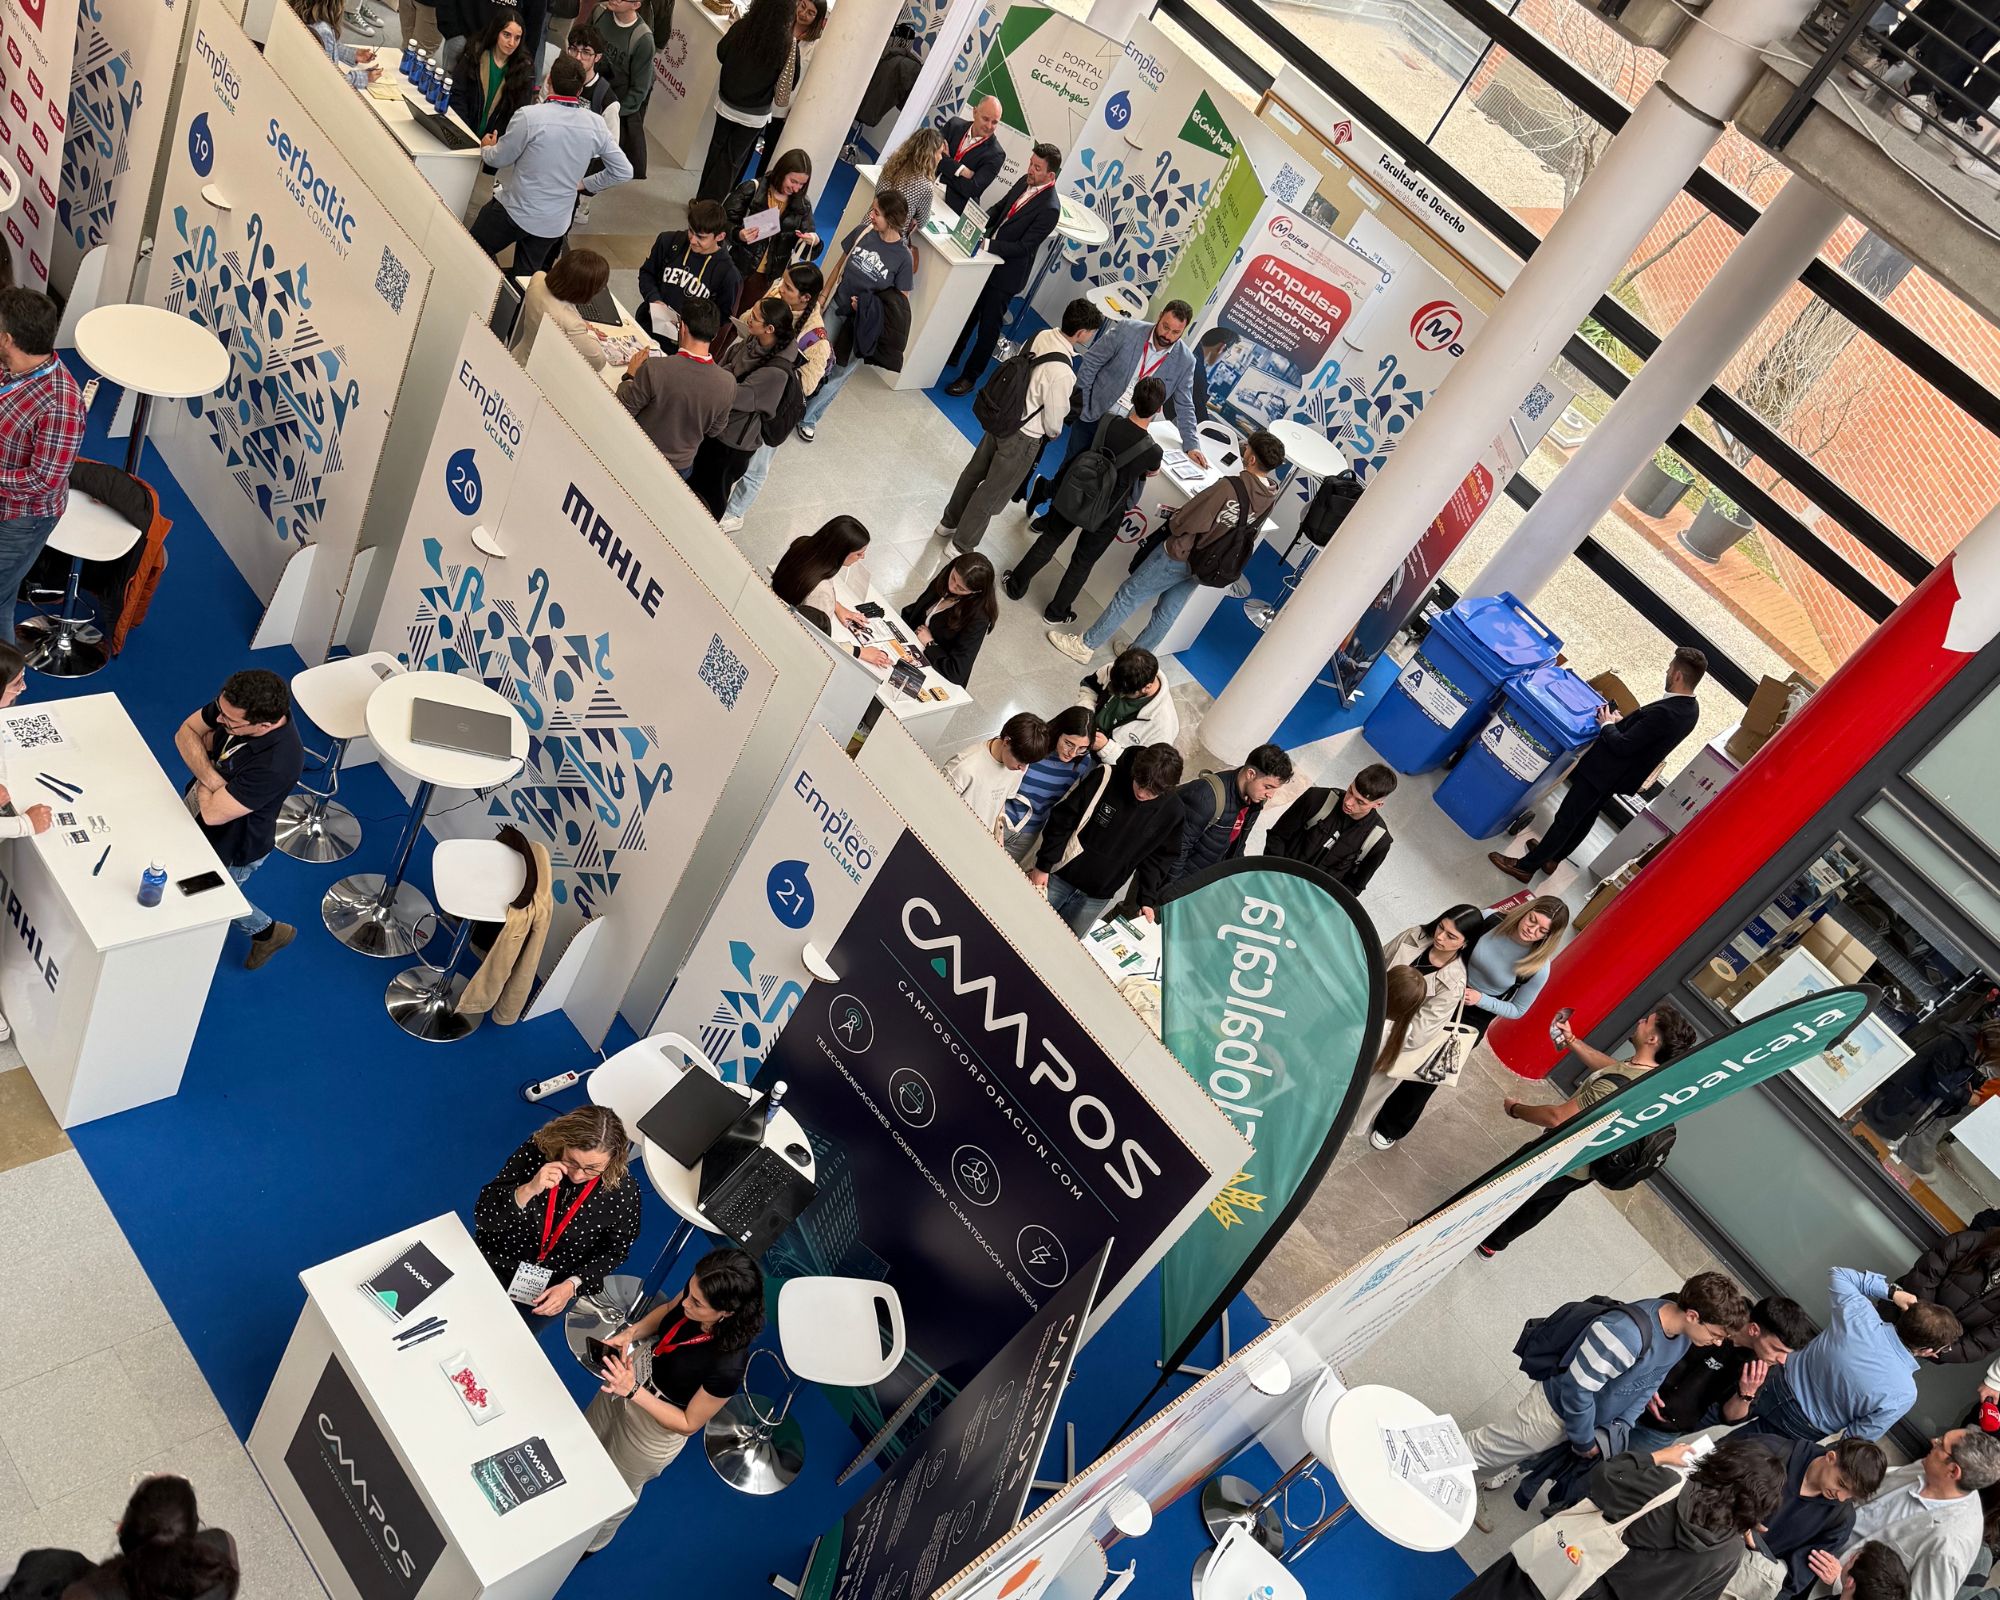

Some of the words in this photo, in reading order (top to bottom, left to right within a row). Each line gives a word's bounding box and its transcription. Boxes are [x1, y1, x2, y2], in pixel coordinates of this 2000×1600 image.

[196, 29, 239, 100] Empleo
[1038, 54, 1054, 68] DE
[1055, 63, 1098, 90] EMPLEO
[1063, 51, 1103, 79] PORTAL
[1124, 40, 1165, 84] Empleo
[1110, 103, 1127, 122] 49
[195, 133, 208, 161] 19
[266, 118, 356, 244] serbatic
[1378, 154, 1418, 192] Facultad
[1416, 187, 1429, 202] de
[1429, 197, 1465, 233] Derecho
[277, 167, 282, 180] A
[285, 175, 306, 207] VASS
[307, 204, 349, 261] COMPANY
[1275, 223, 1309, 249] Meisa
[1255, 278, 1263, 286] tu
[1261, 281, 1331, 335] CARRERA
[1262, 259, 1342, 319] ¡Impulsa
[1234, 302, 1256, 319] laborales
[1255, 317, 1267, 327] para
[1267, 325, 1295, 346] estudiantes
[1244, 287, 1257, 298] con
[1254, 291, 1326, 345] Nosotros!
[1272, 336, 1292, 352] perfiles
[459, 360, 521, 446] Empleo
[493, 389, 500, 401] 19
[504, 402, 517, 422] Foro
[516, 419, 525, 432] de
[484, 419, 515, 461] UCLM3E
[452, 466, 477, 504] 20
[562, 482, 664, 619] MAHLE
[1428, 670, 1440, 682] SOLO
[1440, 681, 1452, 695] PAPEL
[1510, 725, 1521, 738] SOLO
[1521, 736, 1534, 749] PAPEL
[794, 770, 872, 870] Empleo
[839, 808, 848, 820] 19
[853, 824, 868, 845] Foro
[869, 844, 878, 857] de
[823, 836, 862, 885] UCLM3E
[776, 878, 805, 915] 21
[901, 897, 1162, 1200] CAMPOS
[898, 980, 1084, 1201] CAMPOSCORPORACION.COM
[816, 1035, 890, 1129] TELECOMUNICACIONES
[892, 1131, 948, 1200] CONSTRUCCIÓN
[949, 1201, 1005, 1271] CLIMATIZACIÓN
[1006, 1270, 1040, 1312] ENERGÍA
[404, 1262, 432, 1289] CAMPOS
[524, 1444, 554, 1484] CAMPOS
[318, 1413, 416, 1578] CAMPOS
